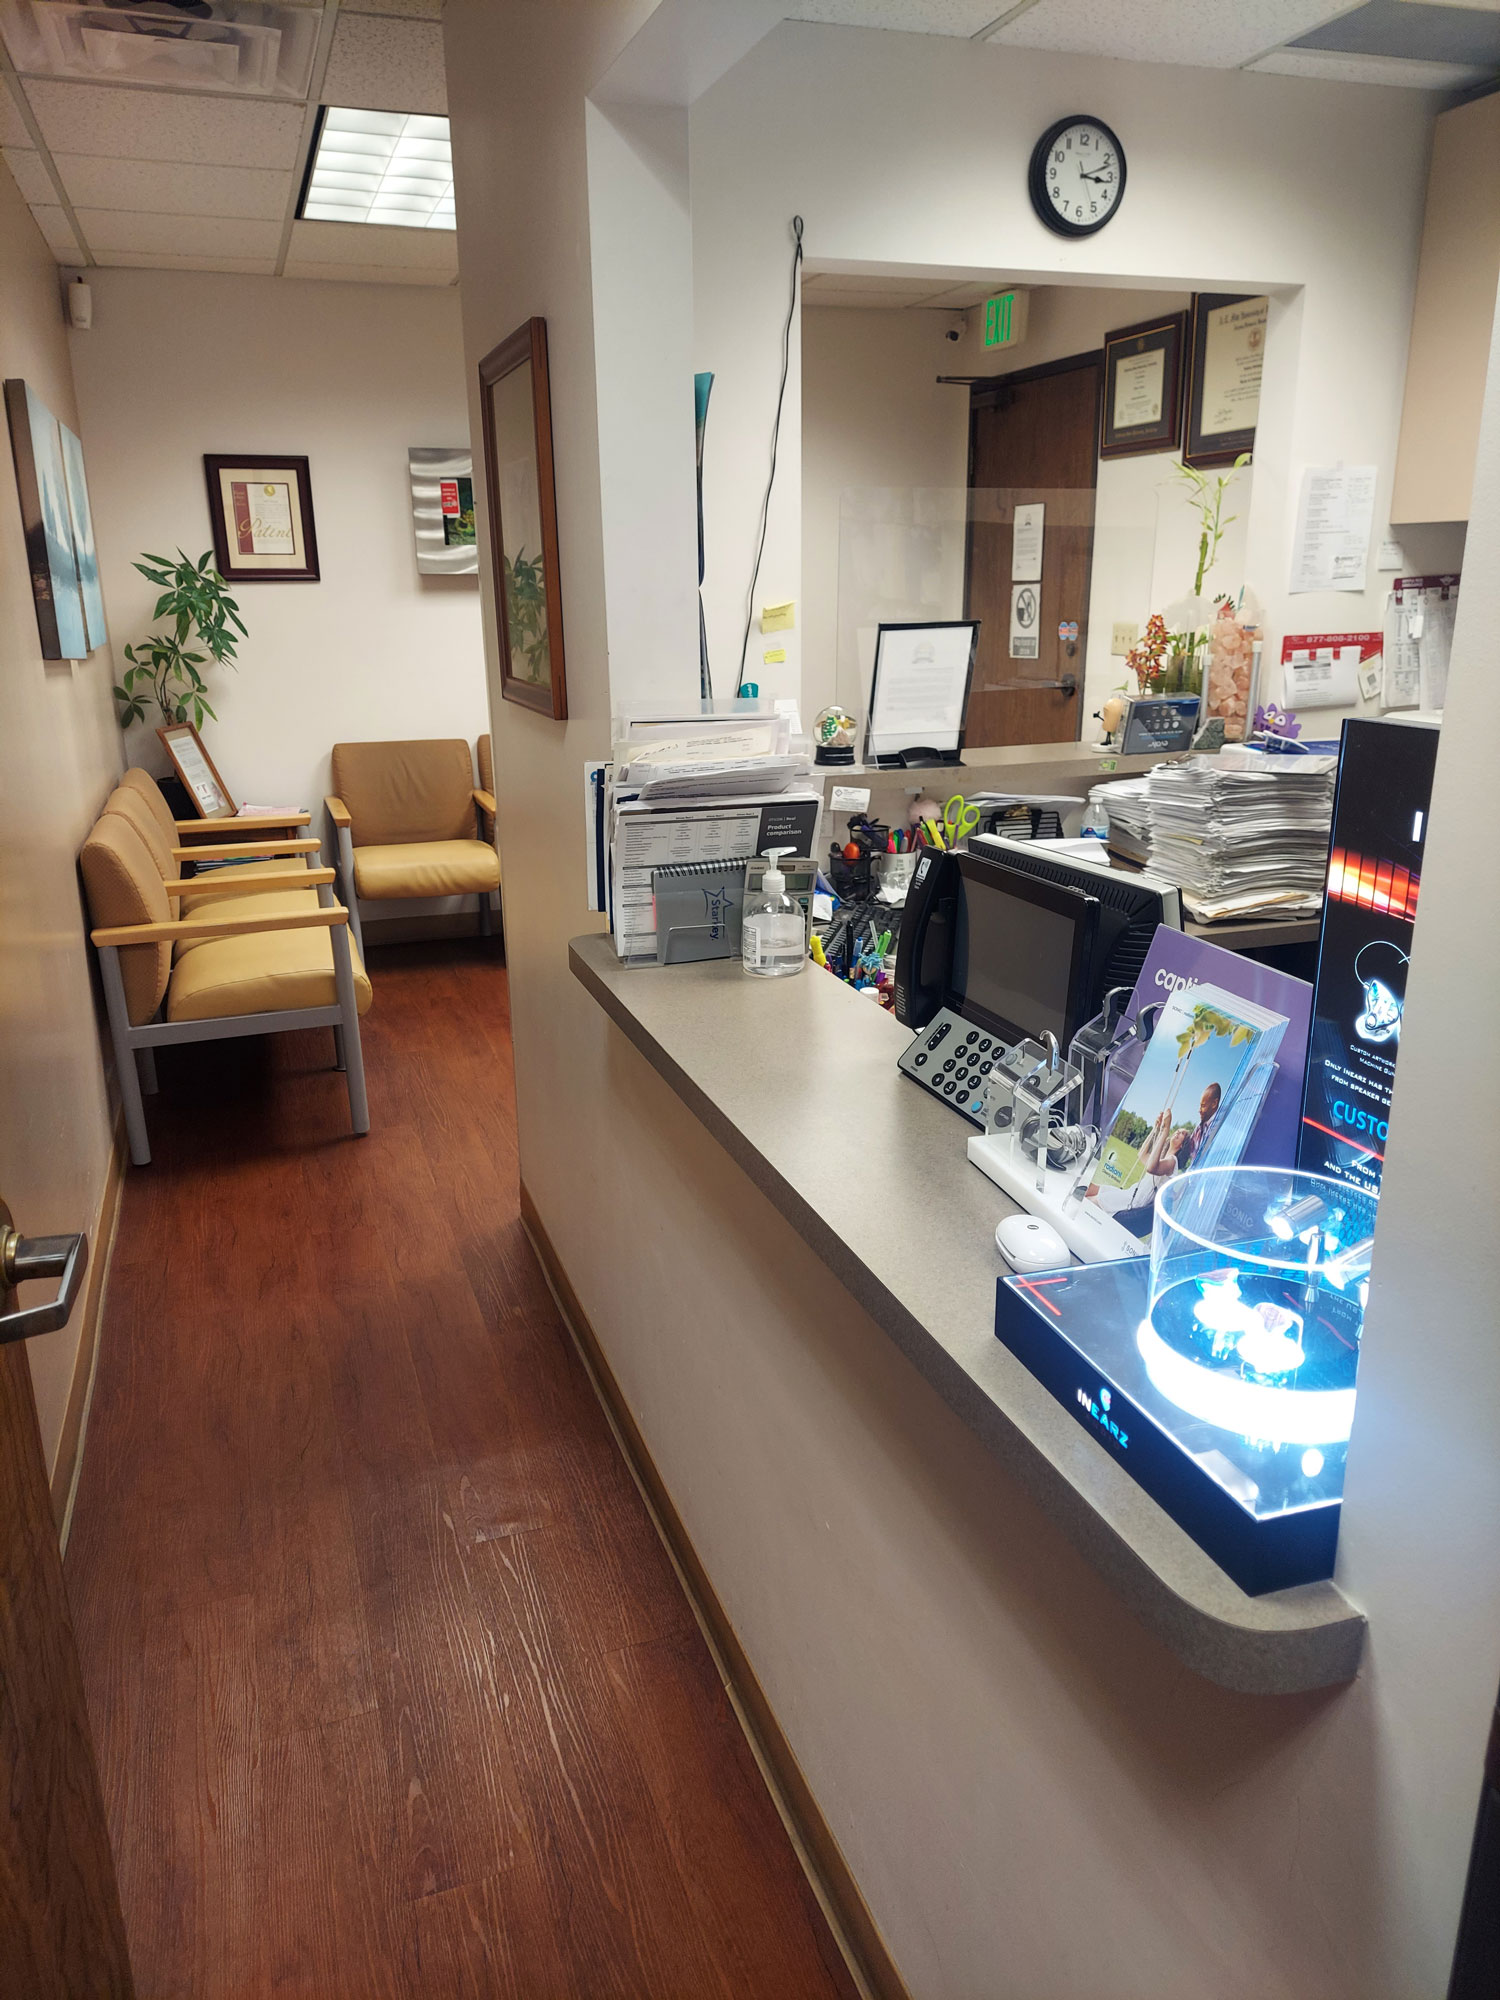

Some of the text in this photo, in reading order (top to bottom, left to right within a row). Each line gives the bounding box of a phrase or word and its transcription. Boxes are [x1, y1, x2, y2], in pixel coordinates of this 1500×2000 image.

[1080, 133, 1090, 147] 12
[1054, 150, 1065, 163] 10
[1103, 152, 1111, 165] 2
[1049, 167, 1057, 180] 9
[1106, 171, 1114, 184] 3
[1052, 186, 1060, 199] 8
[1101, 188, 1108, 200] 4
[1063, 199, 1070, 212] 7
[1075, 205, 1083, 217] 6
[1090, 201, 1098, 213] 5
[985, 294, 1014, 346] EXIT
[766, 829, 802, 837] comparison
[1324, 1059, 1341, 1072] ONLY
[1343, 1067, 1367, 1084] INEARZ
[1368, 1080, 1383, 1091] HAS
[1331, 1074, 1349, 1087] FROM
[1350, 1083, 1380, 1102] SPEAKER
[1333, 1100, 1389, 1141] CUSTO
[1324, 1160, 1342, 1174] AND
[1344, 1170, 1362, 1185] THE
[1351, 1159, 1376, 1178] FROM
[1077, 1389, 1129, 1449] INEARZ
